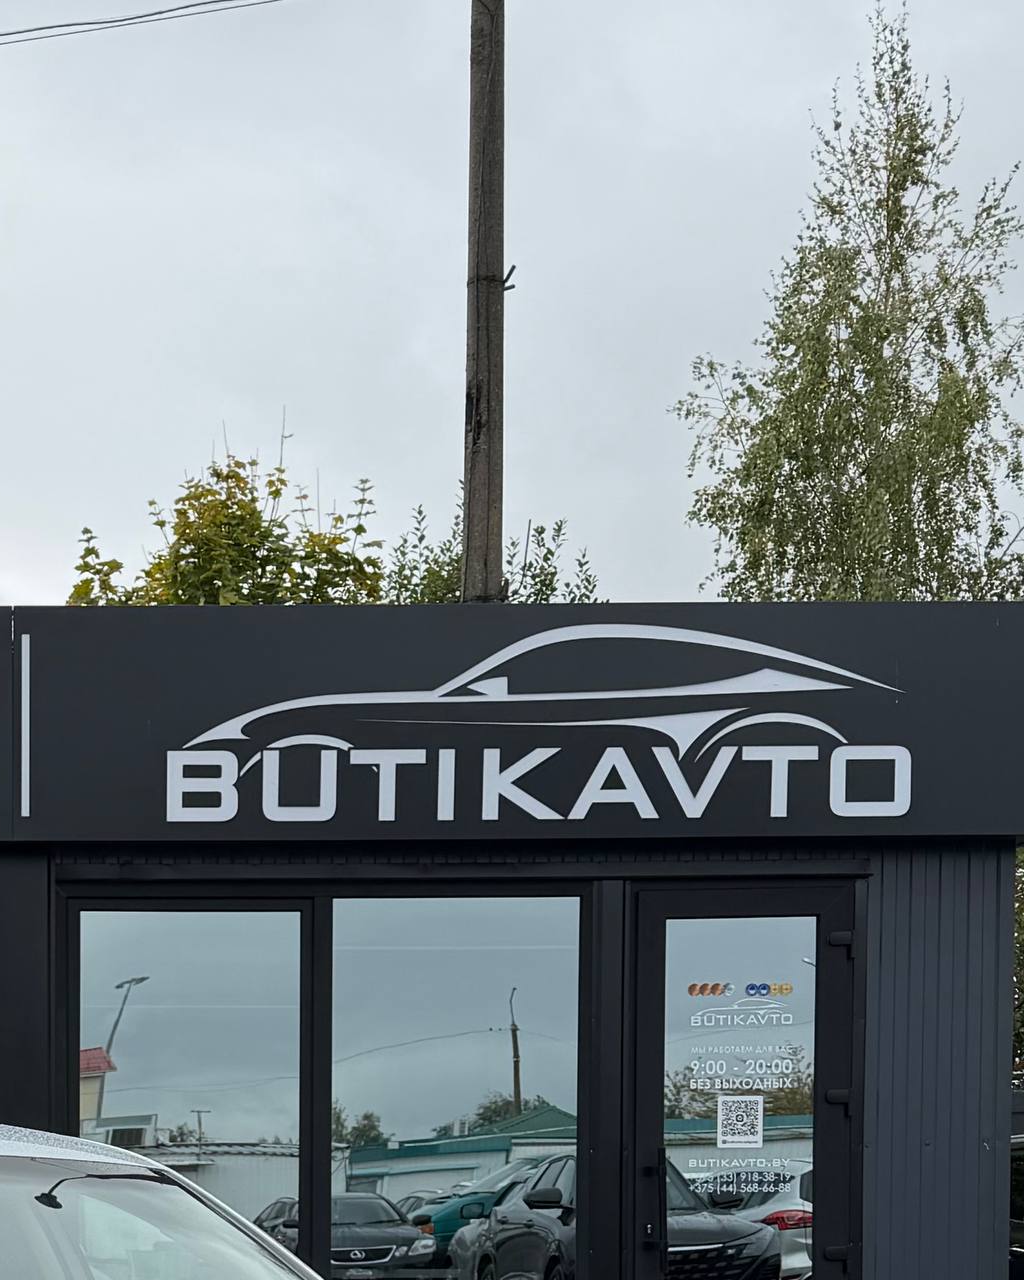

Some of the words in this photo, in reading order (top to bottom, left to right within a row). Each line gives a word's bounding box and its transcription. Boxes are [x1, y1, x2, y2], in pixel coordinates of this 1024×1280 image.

[165, 744, 913, 822] BUTIKAVTO
[690, 1013, 793, 1027] BUTIKAVTO
[690, 1059, 727, 1075] 9:00
[745, 1059, 793, 1075] 20:00
[689, 1079, 711, 1090] БЕЗ
[714, 1077, 793, 1090] ВЫХОДНЫХ
[688, 1158, 791, 1168] BUTIKAVTO.BY
[739, 1172, 792, 1182] 918-38-19
[688, 1183, 714, 1193] +375
[717, 1183, 736, 1195] (44)
[739, 1183, 792, 1193] 568-66-88
